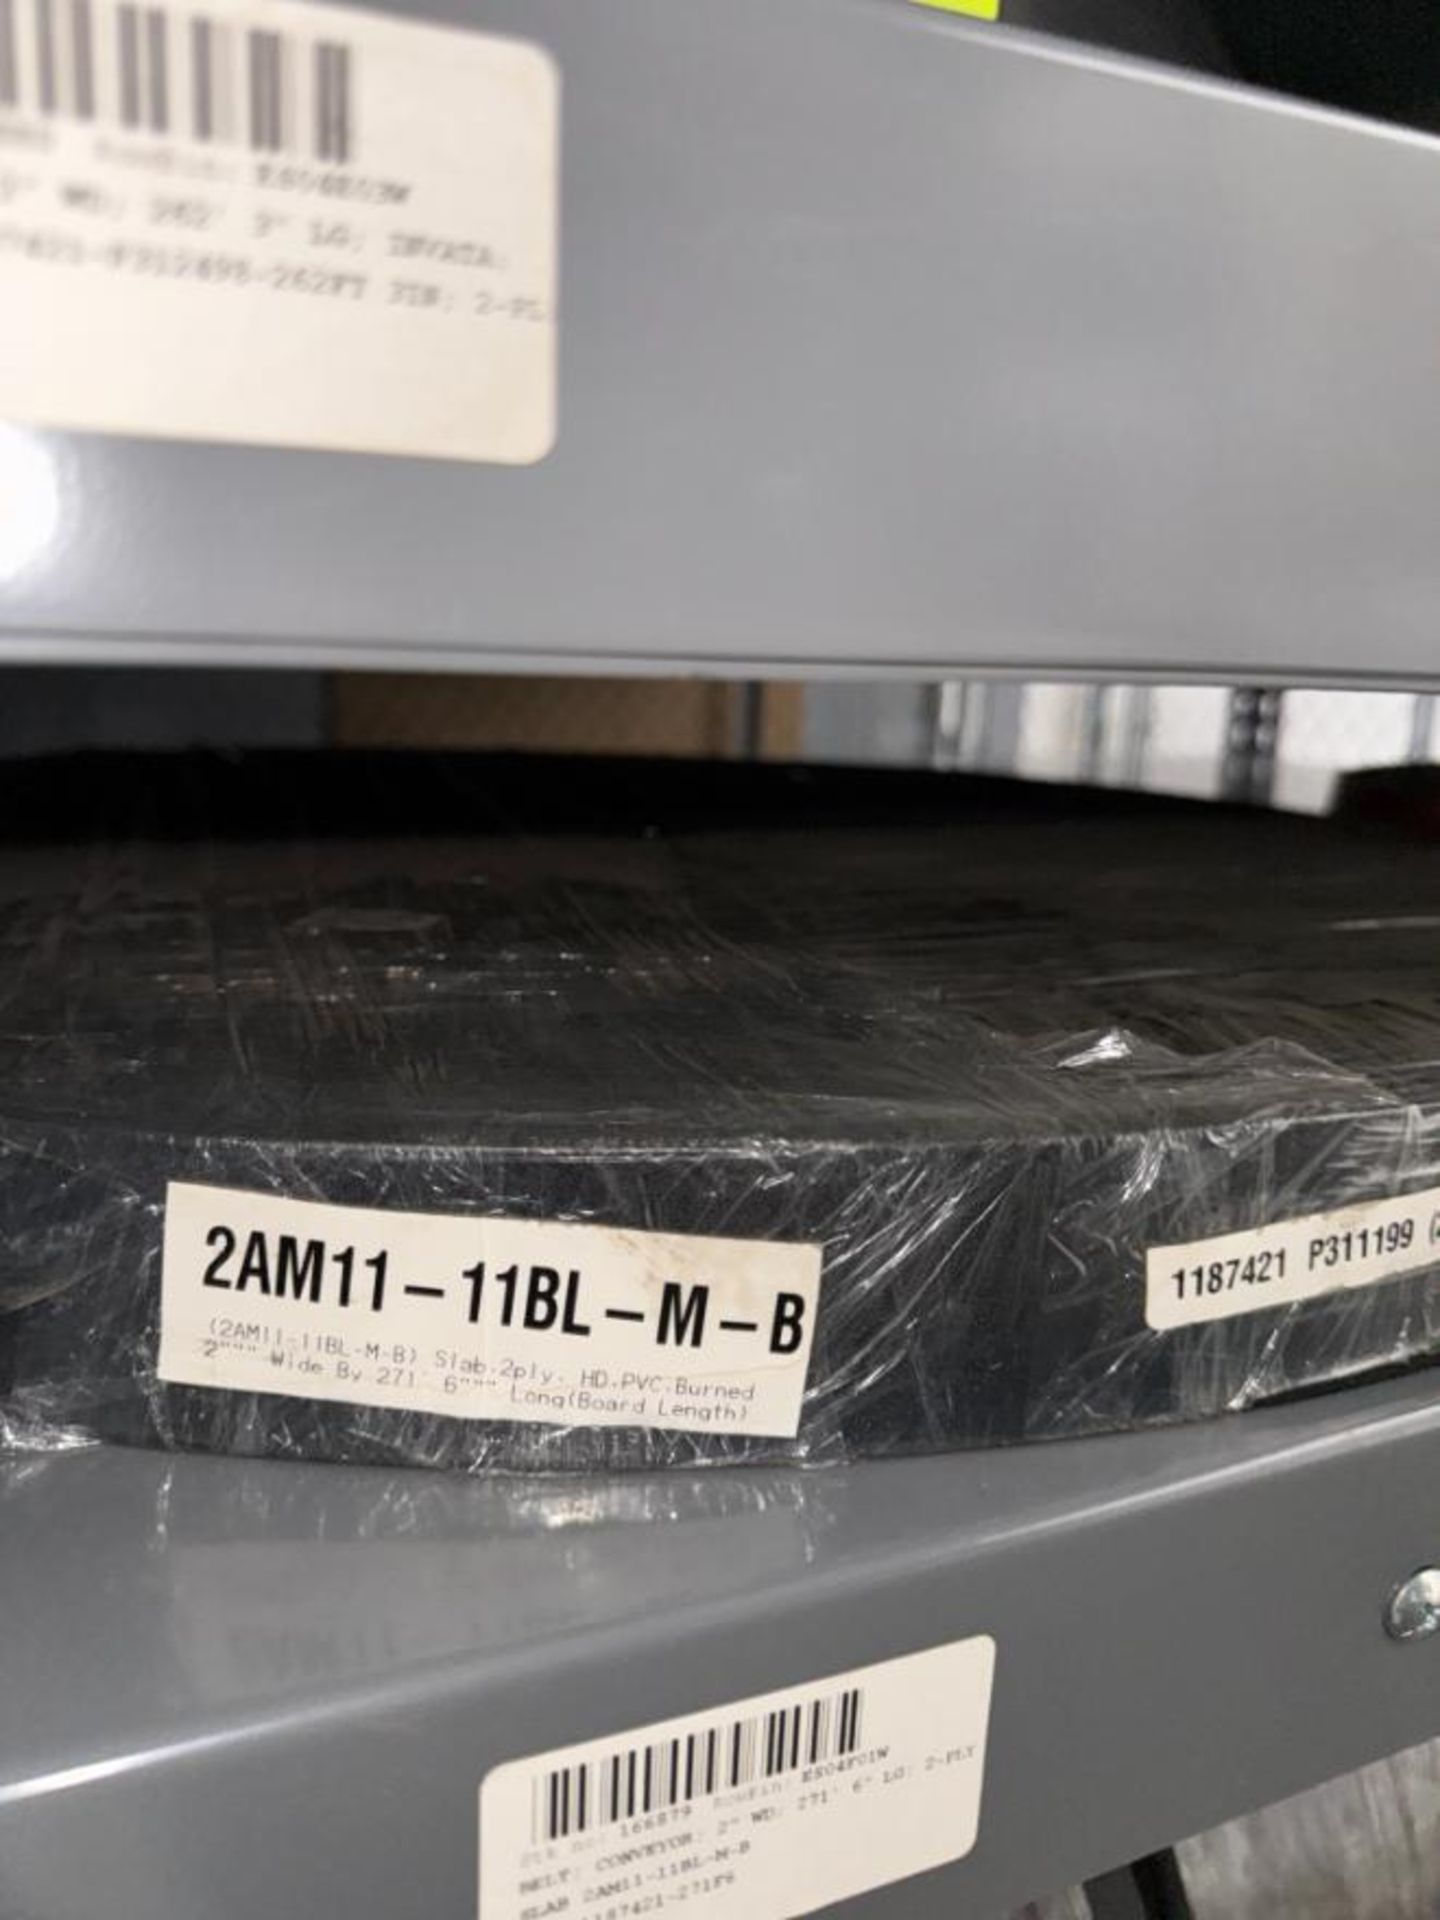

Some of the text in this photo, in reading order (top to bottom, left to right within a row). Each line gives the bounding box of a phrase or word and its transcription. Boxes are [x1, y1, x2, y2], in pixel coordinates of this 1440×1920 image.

[1171, 1247, 1286, 1300] 1187421
[1308, 1218, 1415, 1270] P311199
[269, 1350, 324, 1374] Wide
[336, 1360, 362, 1382] By
[657, 1398, 748, 1422] Length)
